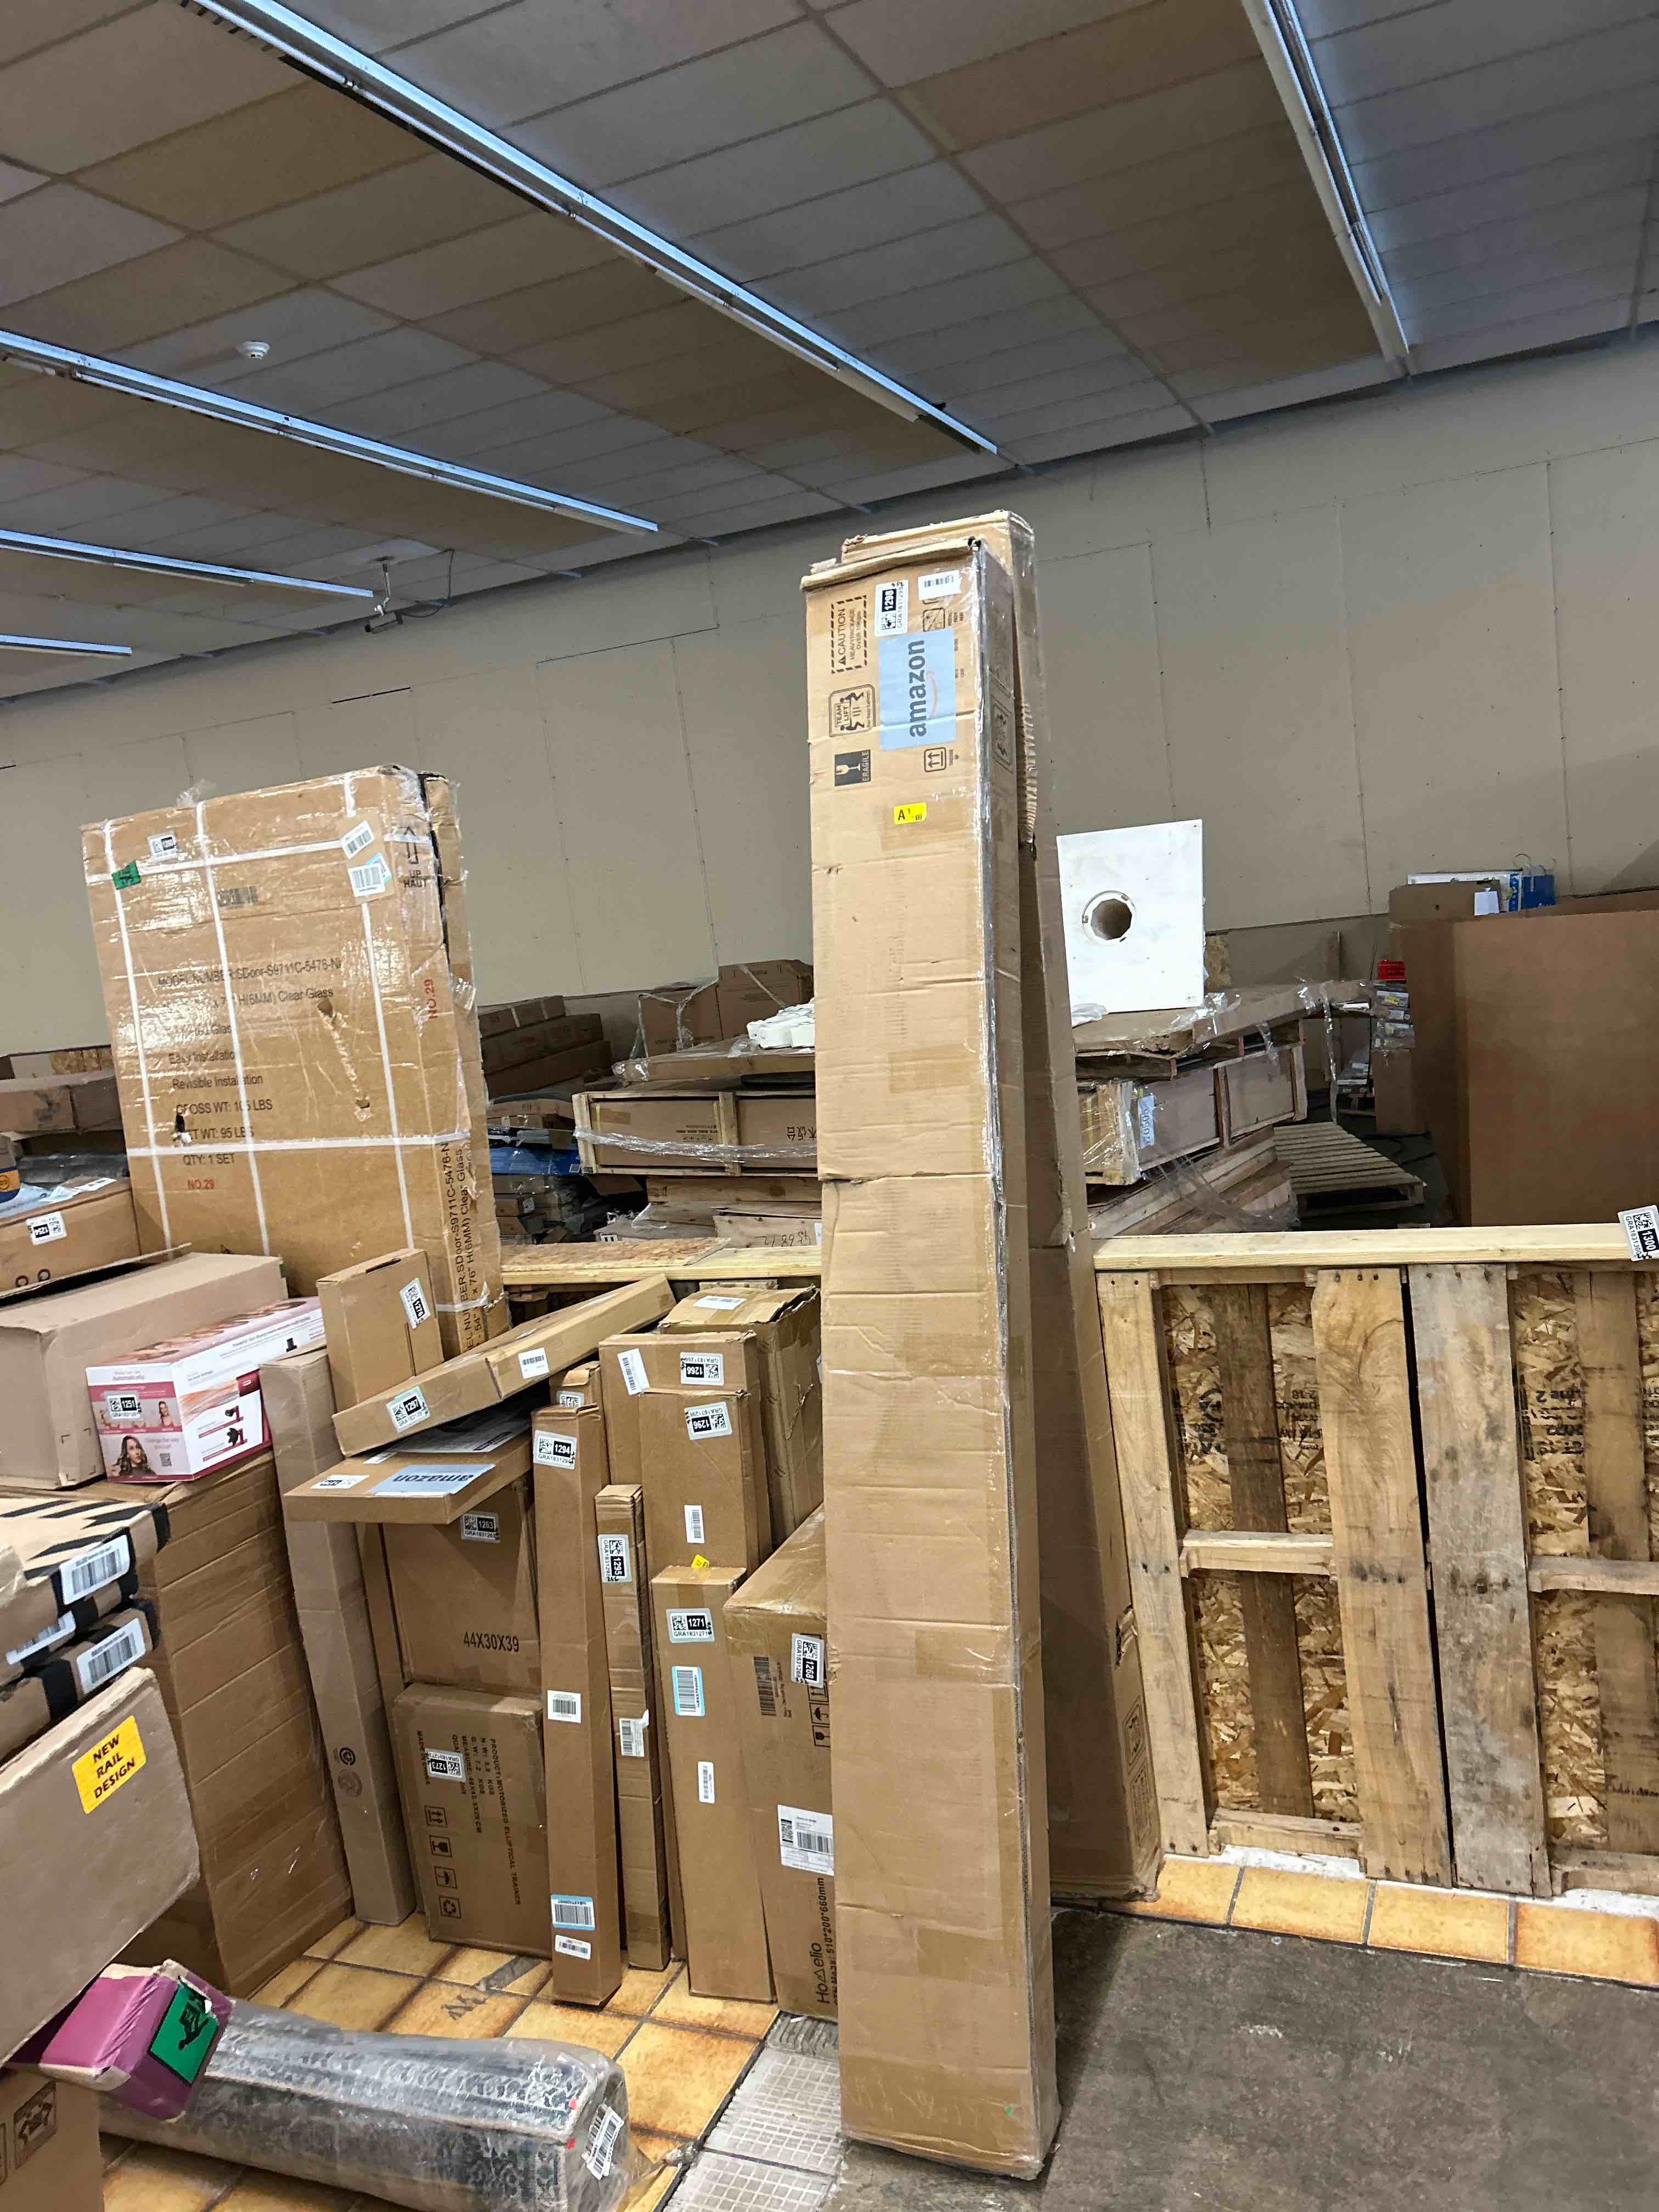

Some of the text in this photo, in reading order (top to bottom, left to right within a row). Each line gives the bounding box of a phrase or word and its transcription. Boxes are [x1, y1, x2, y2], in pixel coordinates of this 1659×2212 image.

[838, 608, 846, 655] CAUTION
[909, 640, 927, 738] amazon
[409, 870, 422, 879] UP
[404, 878, 428, 888] HAUT
[278, 990, 303, 1002] Clear
[306, 987, 334, 999] Glass
[424, 979, 438, 1019] NO.29
[168, 1049, 236, 1065] Easy Installatio
[172, 1075, 263, 1090] Revisible Instalation
[215, 1101, 231, 1113] WT:
[253, 1098, 273, 1110] LBS
[201, 1127, 219, 1139] WT:
[221, 1127, 233, 1138] 95
[183, 1154, 206, 1166] QTY:
[216, 1153, 236, 1164] SET
[456, 1149, 466, 1182] Glass
[187, 1179, 215, 1190] NO.29
[460, 1185, 470, 1215] Clear
[1641, 1231, 1656, 1251] 1300
[686, 1366, 703, 1376] 1266
[692, 1419, 710, 1430] 1296
[555, 1443, 571, 1454] 1294
[393, 1474, 475, 1482] amazon
[478, 1520, 494, 1530] 1263
[613, 1557, 623, 1576] 1295
[688, 1618, 705, 1628] 1271
[464, 1632, 519, 1652] 44X30X39
[805, 1660, 815, 1680] 1268
[92, 1734, 120, 1764] NEW
[96, 1752, 124, 1779] RAIL
[431, 1761, 447, 1771] 1273
[94, 1757, 136, 1799] DESIGN
